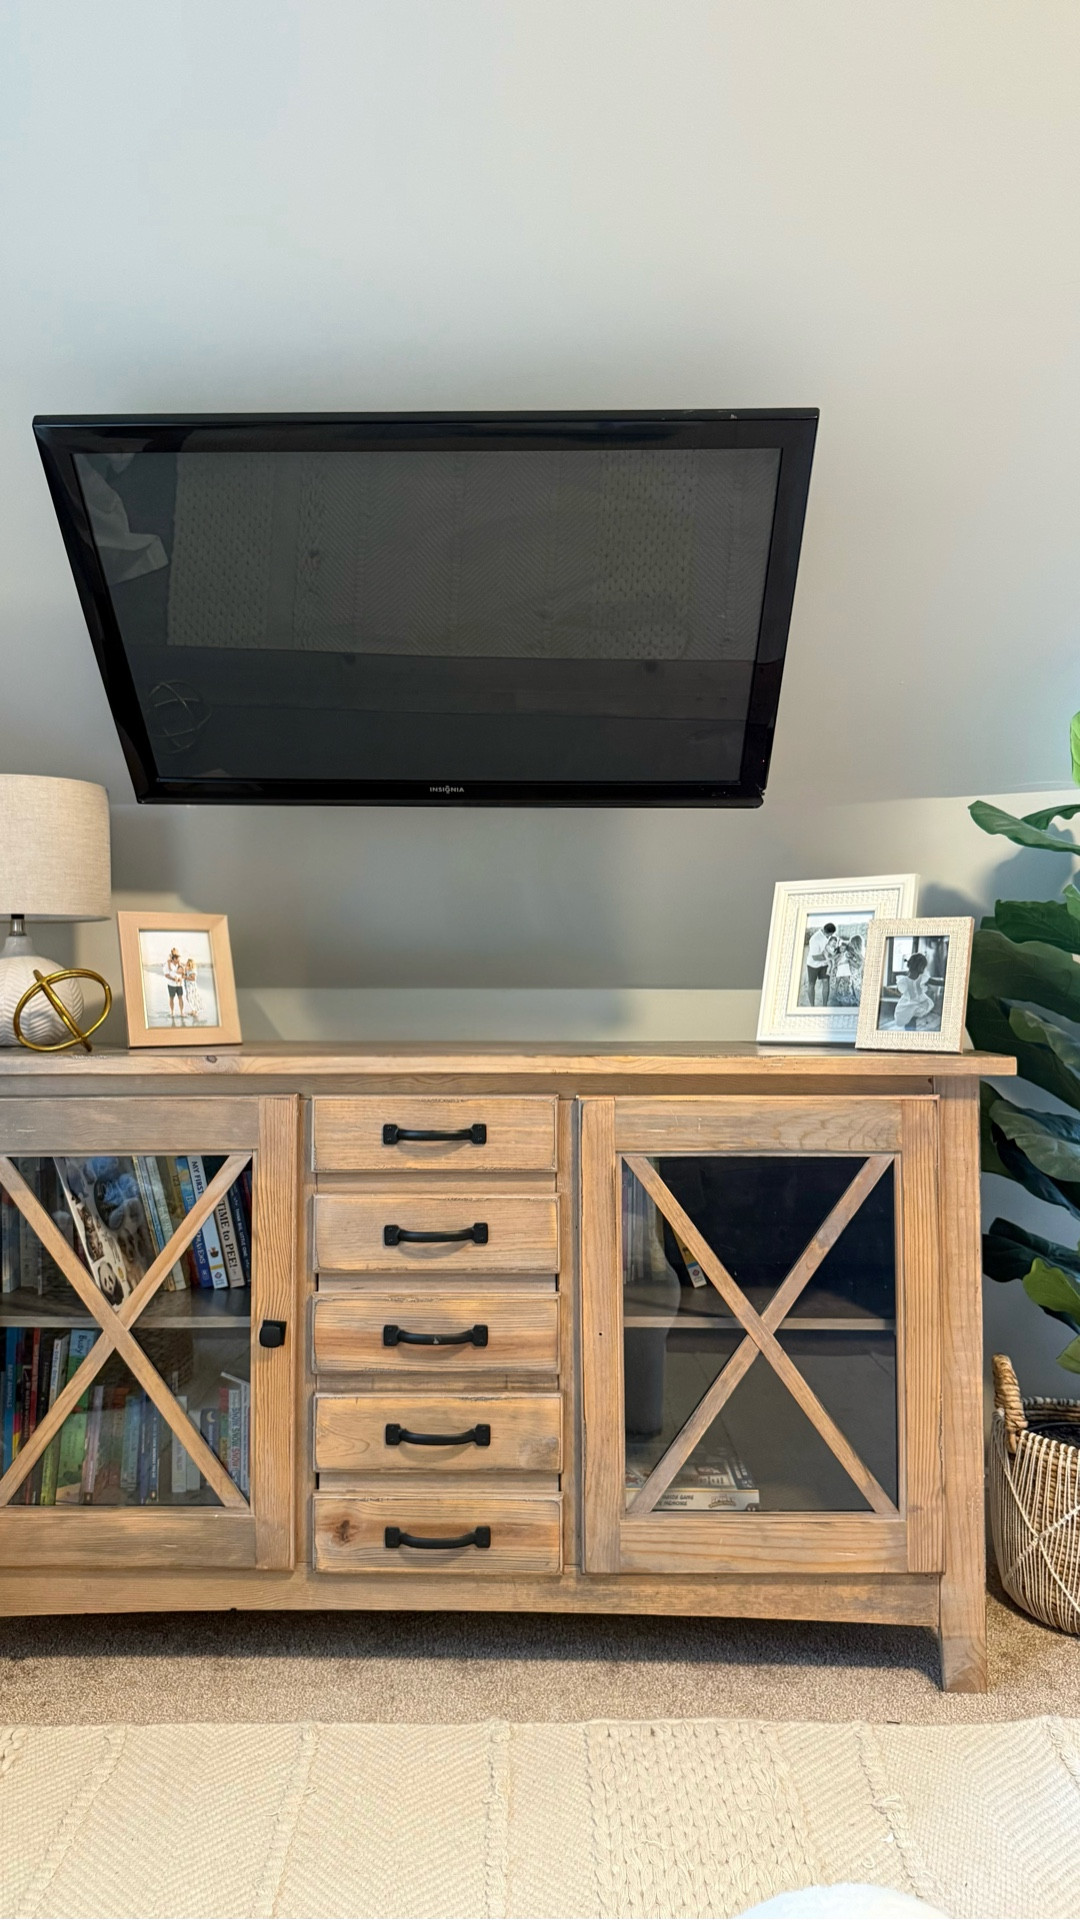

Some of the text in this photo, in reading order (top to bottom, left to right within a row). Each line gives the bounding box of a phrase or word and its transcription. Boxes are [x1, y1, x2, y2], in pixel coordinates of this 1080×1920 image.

[430, 785, 465, 794] INSIGNIA
[192, 1161, 205, 1195] MY FIRST
[222, 1231, 231, 1241] to
[225, 1243, 238, 1268] PEE!
[76, 1335, 86, 1353] Busy
